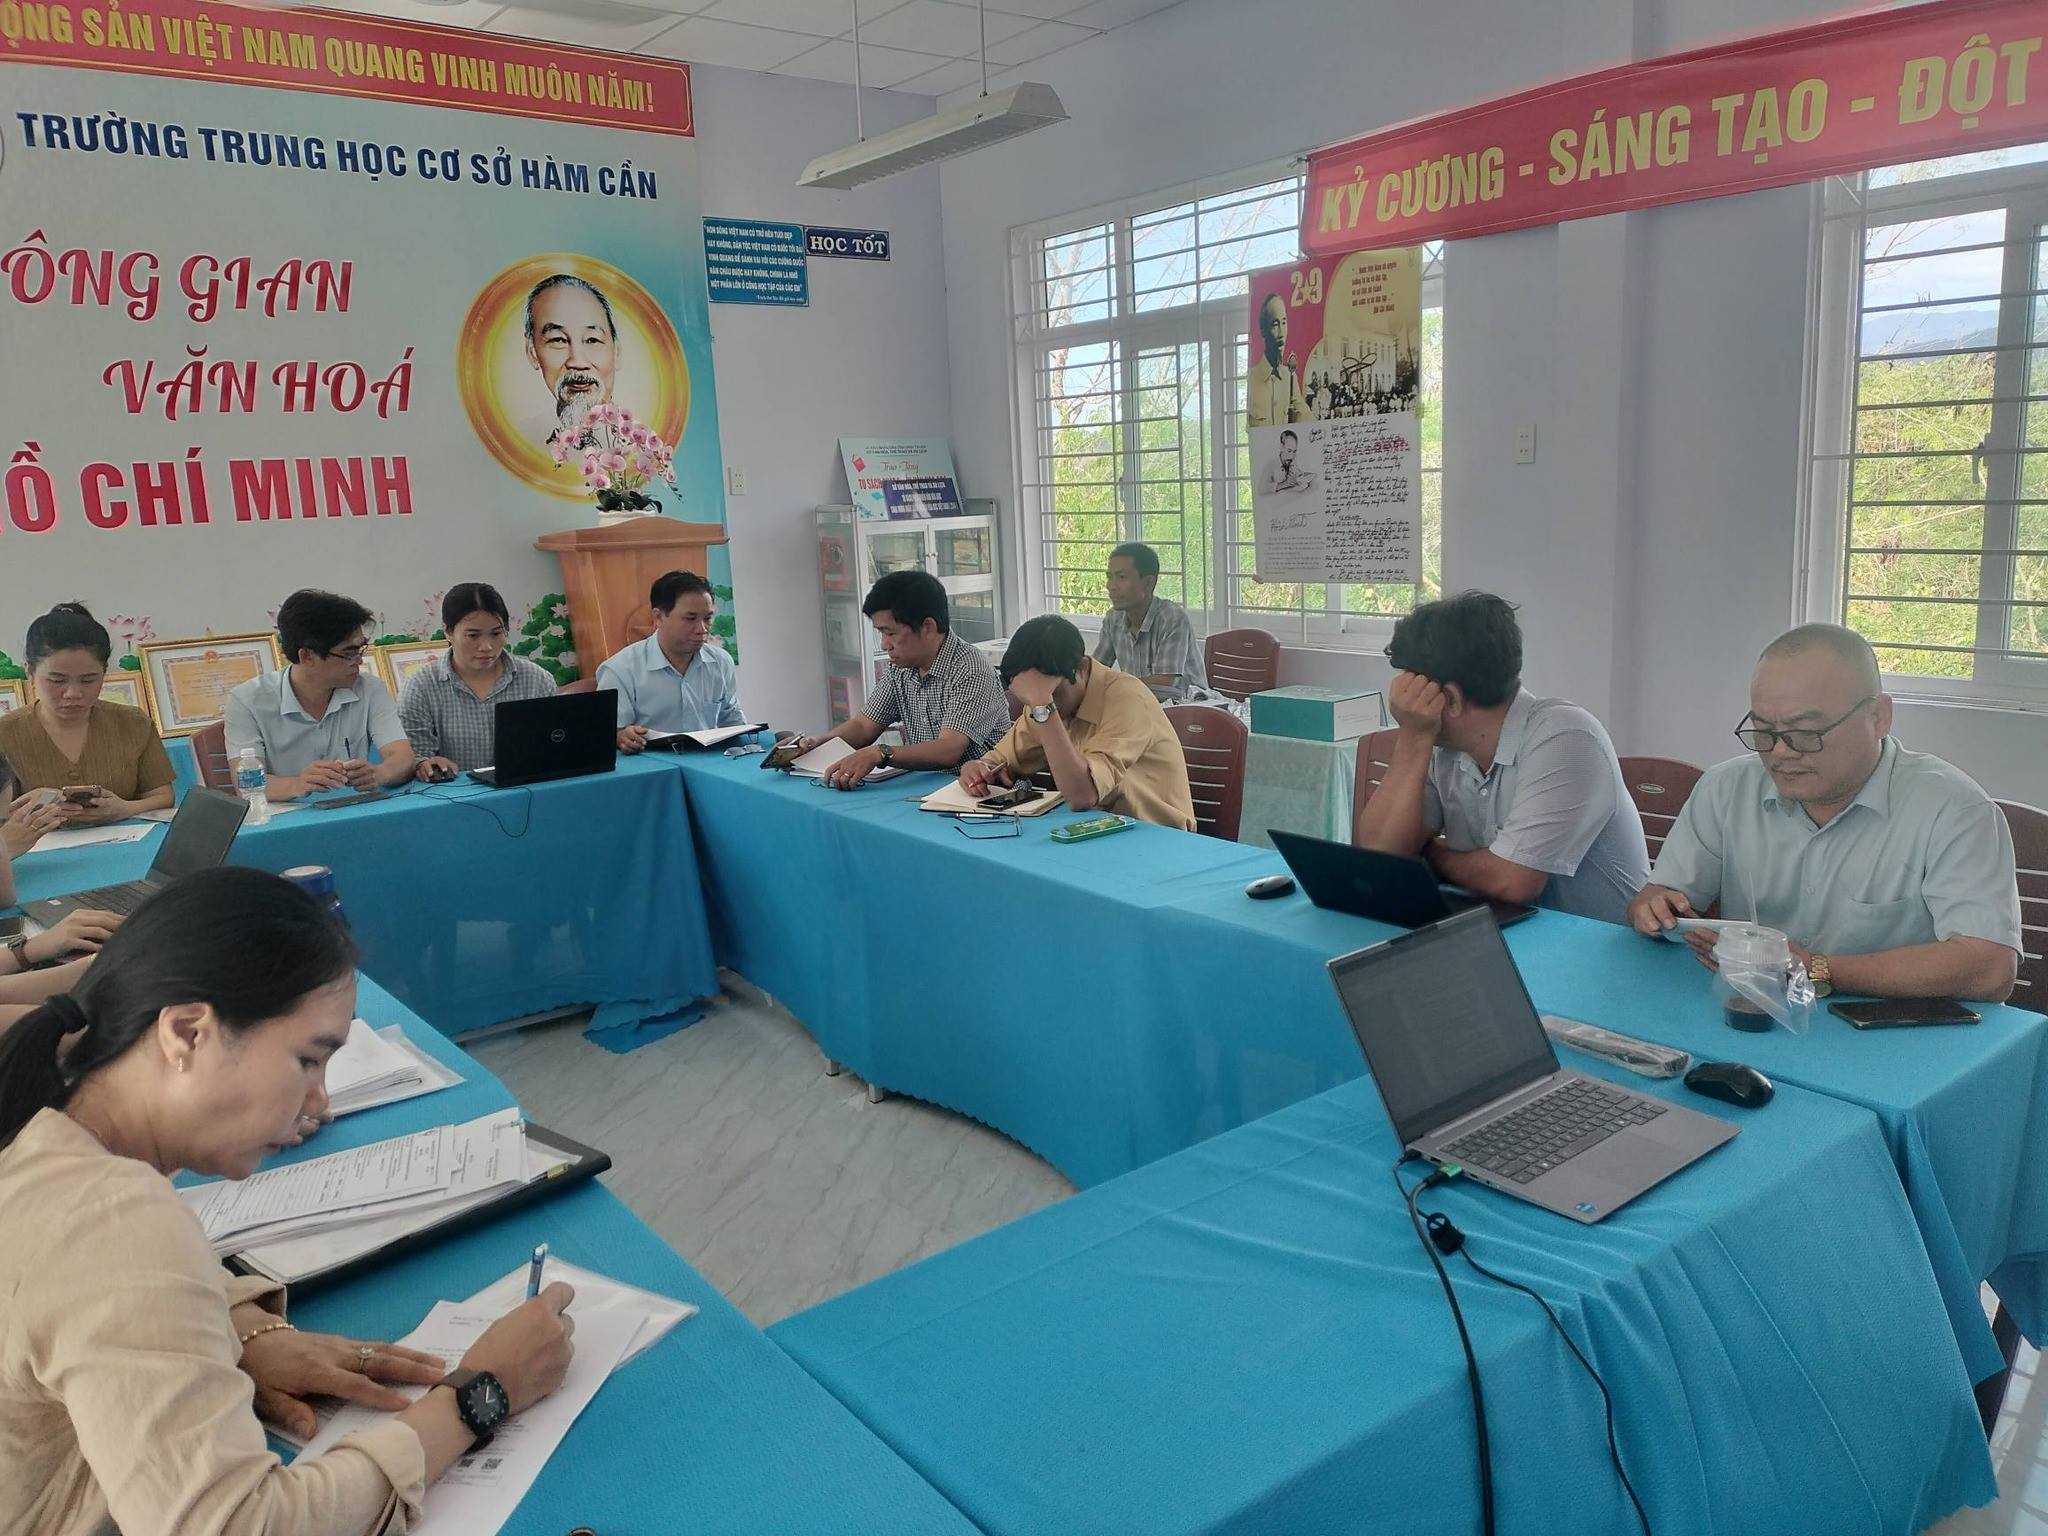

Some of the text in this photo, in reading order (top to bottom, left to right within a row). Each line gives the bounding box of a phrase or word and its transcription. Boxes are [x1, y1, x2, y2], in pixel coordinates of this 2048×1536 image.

[81, 0, 155, 51] SẢN
[161, 16, 233, 66] VIỆT
[242, 27, 318, 70] NAM
[325, 38, 425, 83] QUANG
[430, 51, 498, 93] VINH
[503, 62, 582, 104] MUÔN
[587, 70, 654, 112] NĂM!
[16, 111, 657, 199] TRƯỜNG TRUNG HỌC CƠ SỞ HÀM CẦN
[1318, 165, 1369, 233] KỶ
[1376, 146, 1505, 222] CƯƠNG
[1549, 108, 1692, 186] SÁNG
[1711, 78, 1828, 164] TẠO
[1899, 32, 2043, 129] ĐỘT
[0, 229, 353, 323] ÔNG GIAN
[809, 234, 886, 254] HỌC TỐT
[102, 344, 415, 421] VĂN HOÁ
[0, 441, 413, 532] Ồ CHÍ MINH
